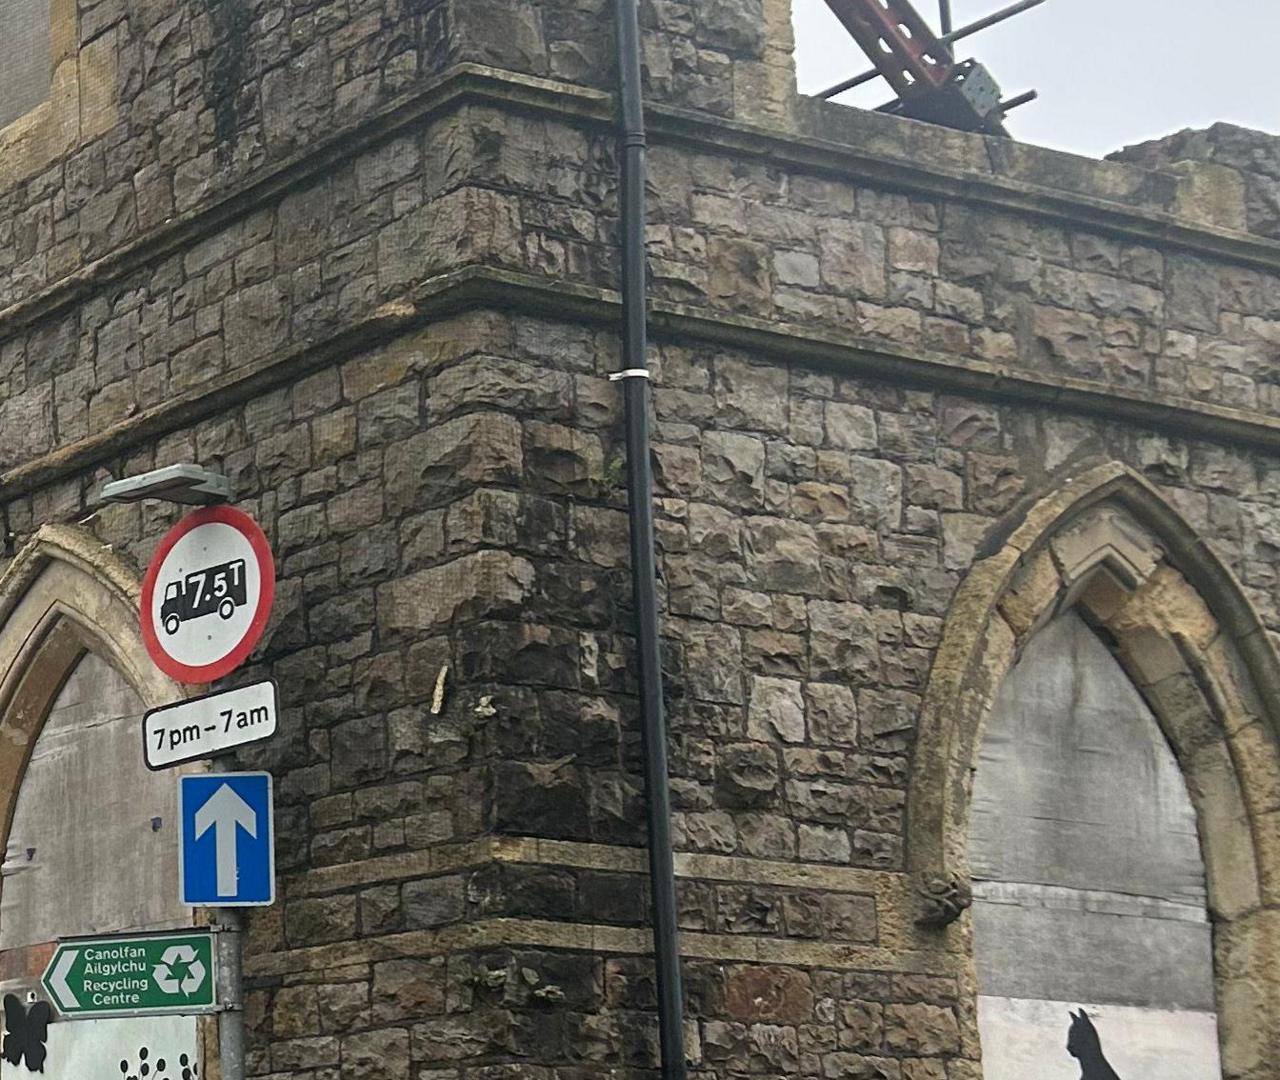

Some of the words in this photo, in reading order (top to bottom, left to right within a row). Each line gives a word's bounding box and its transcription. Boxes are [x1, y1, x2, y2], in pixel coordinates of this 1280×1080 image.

[84, 947, 146, 961] Canolfan
[84, 960, 147, 976] Ailgylchu
[83, 978, 148, 992] Recycling
[92, 993, 140, 1005] Centre
